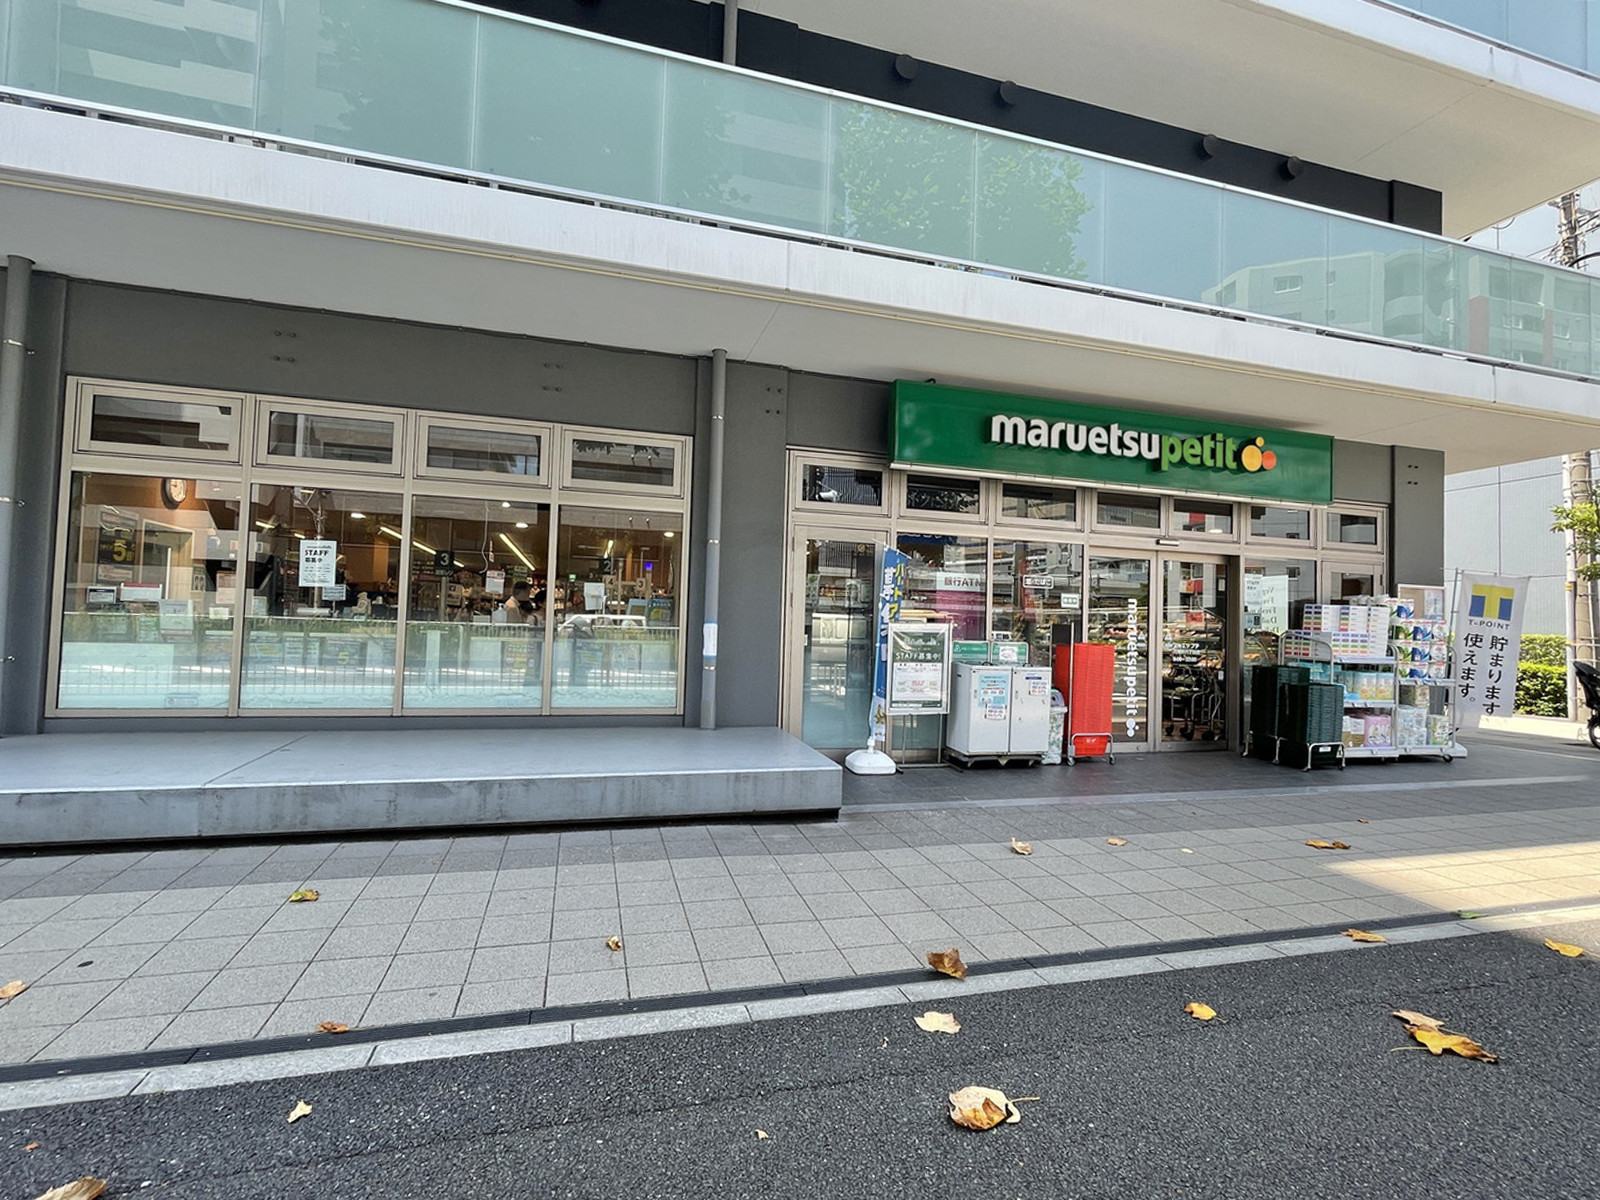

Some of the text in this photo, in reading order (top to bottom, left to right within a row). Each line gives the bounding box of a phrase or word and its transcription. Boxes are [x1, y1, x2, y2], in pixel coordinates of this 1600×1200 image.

[991, 414, 1238, 471] maruetsupetit
[440, 553, 449, 566] 3
[604, 560, 612, 572] 2
[638, 580, 644, 588] 3
[1124, 598, 1140, 716] maruetsupetit
[1458, 632, 1484, 703] 使えます。
[1482, 635, 1509, 716] 貯まります
